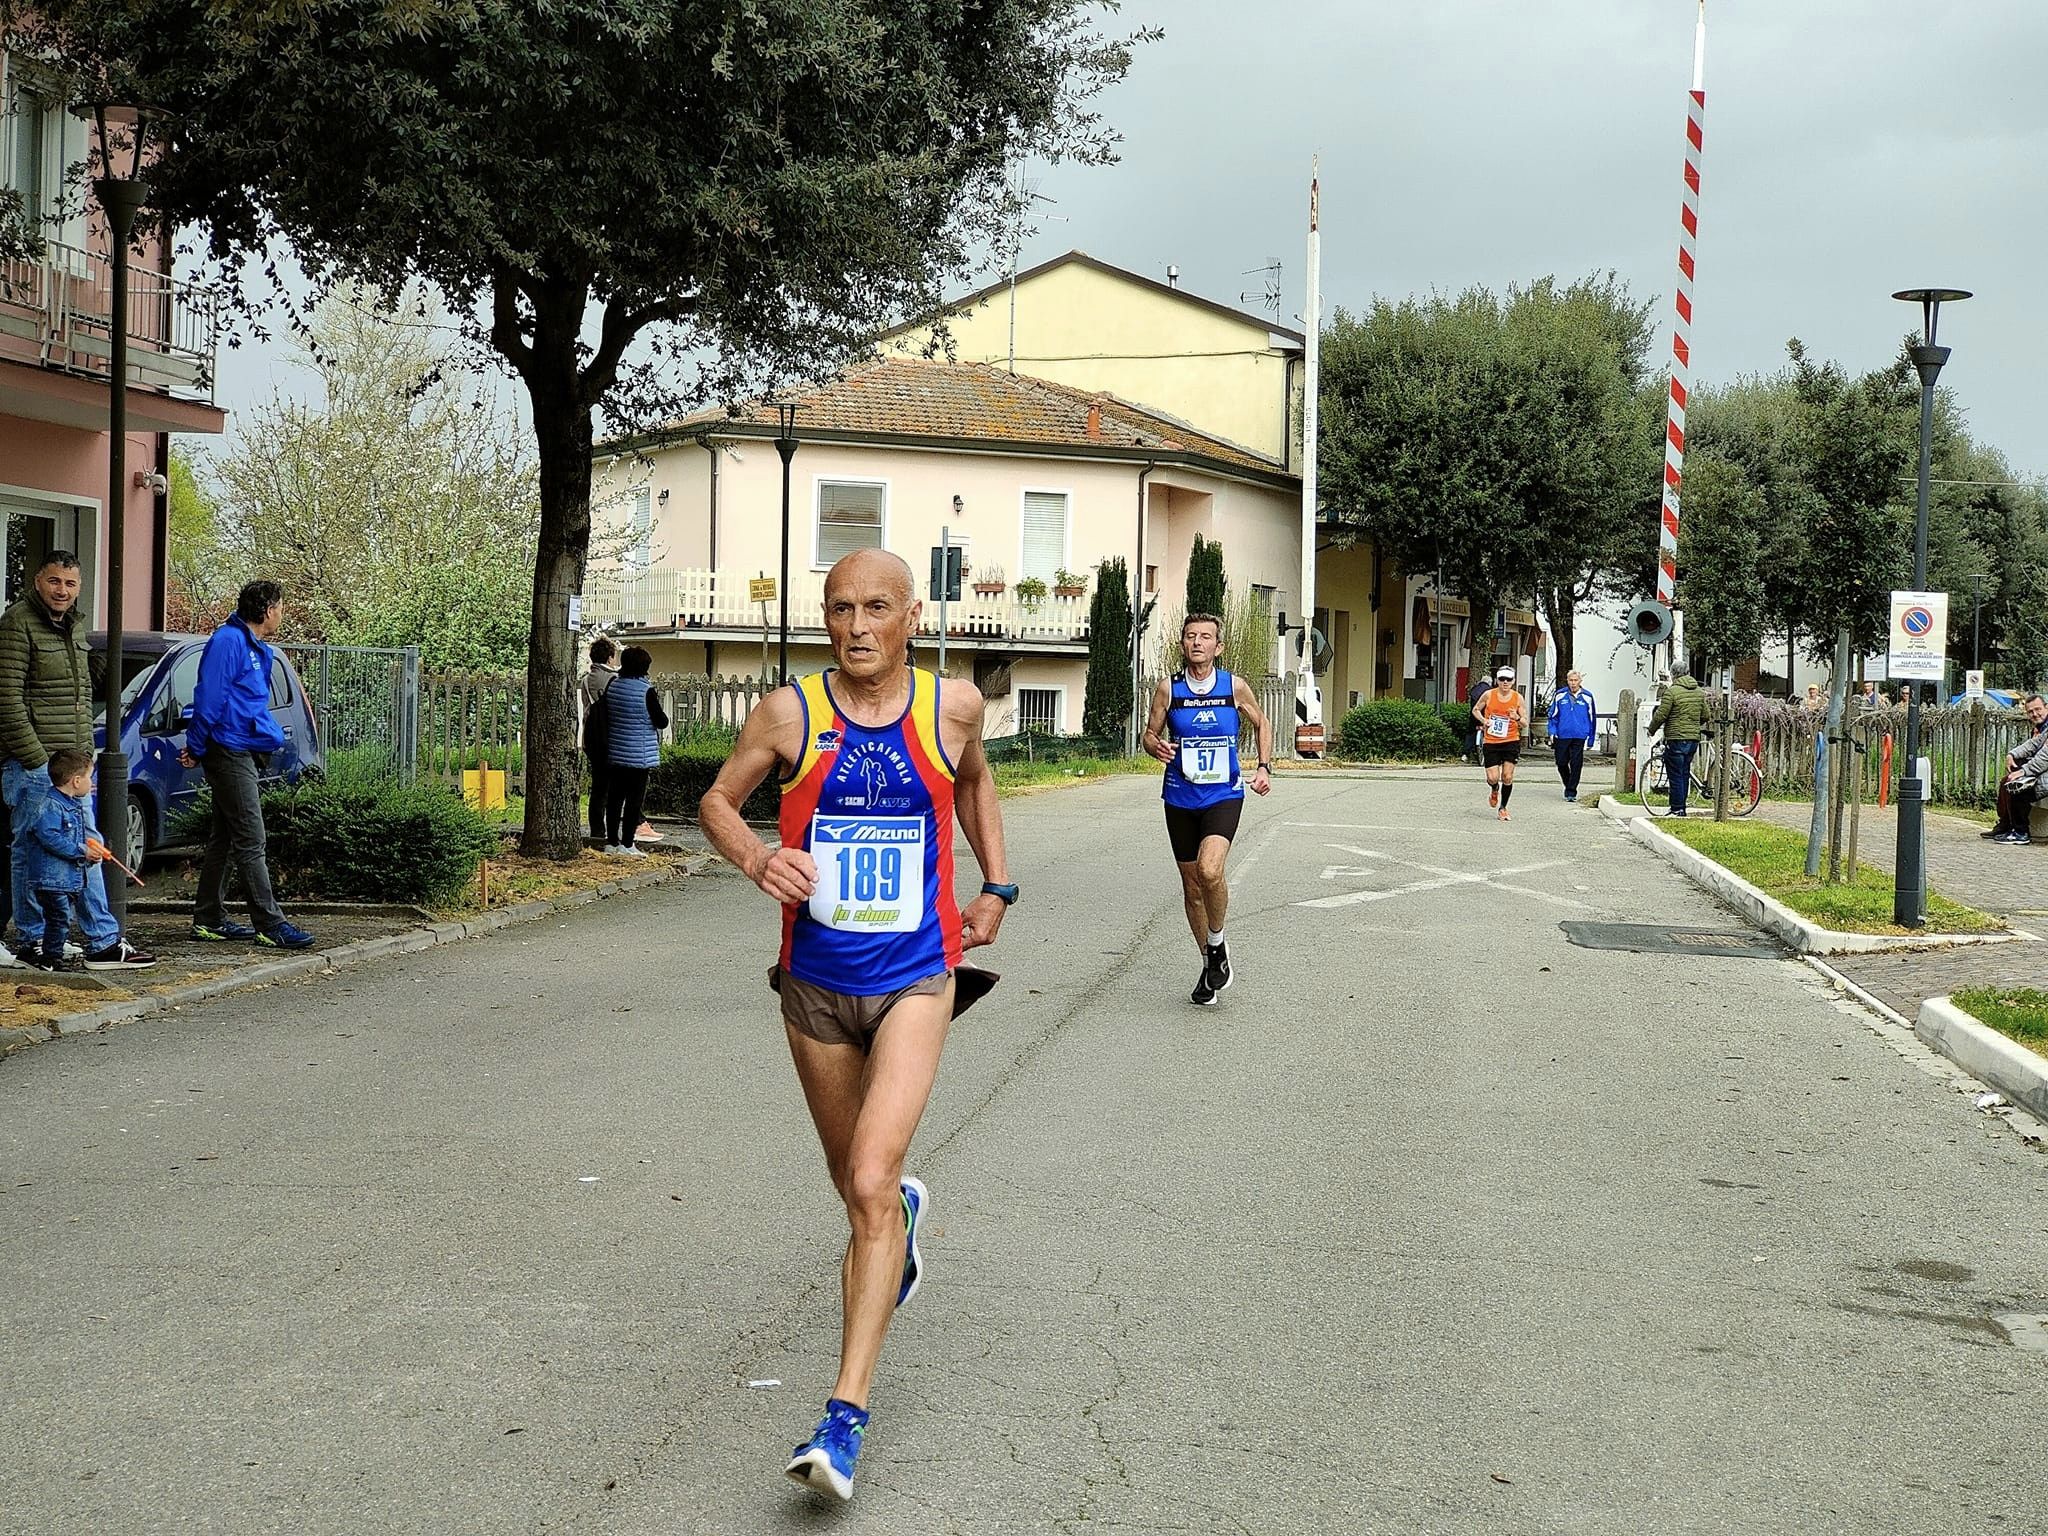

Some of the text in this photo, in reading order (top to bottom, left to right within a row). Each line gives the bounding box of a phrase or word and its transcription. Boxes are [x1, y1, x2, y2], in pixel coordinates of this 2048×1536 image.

[1183, 699, 1226, 707] BeRunners
[1192, 710, 1217, 723] AXA
[1493, 720, 1504, 731] 59
[1197, 748, 1216, 771] 57
[878, 797, 911, 809] AVIS
[836, 847, 902, 902] 189
